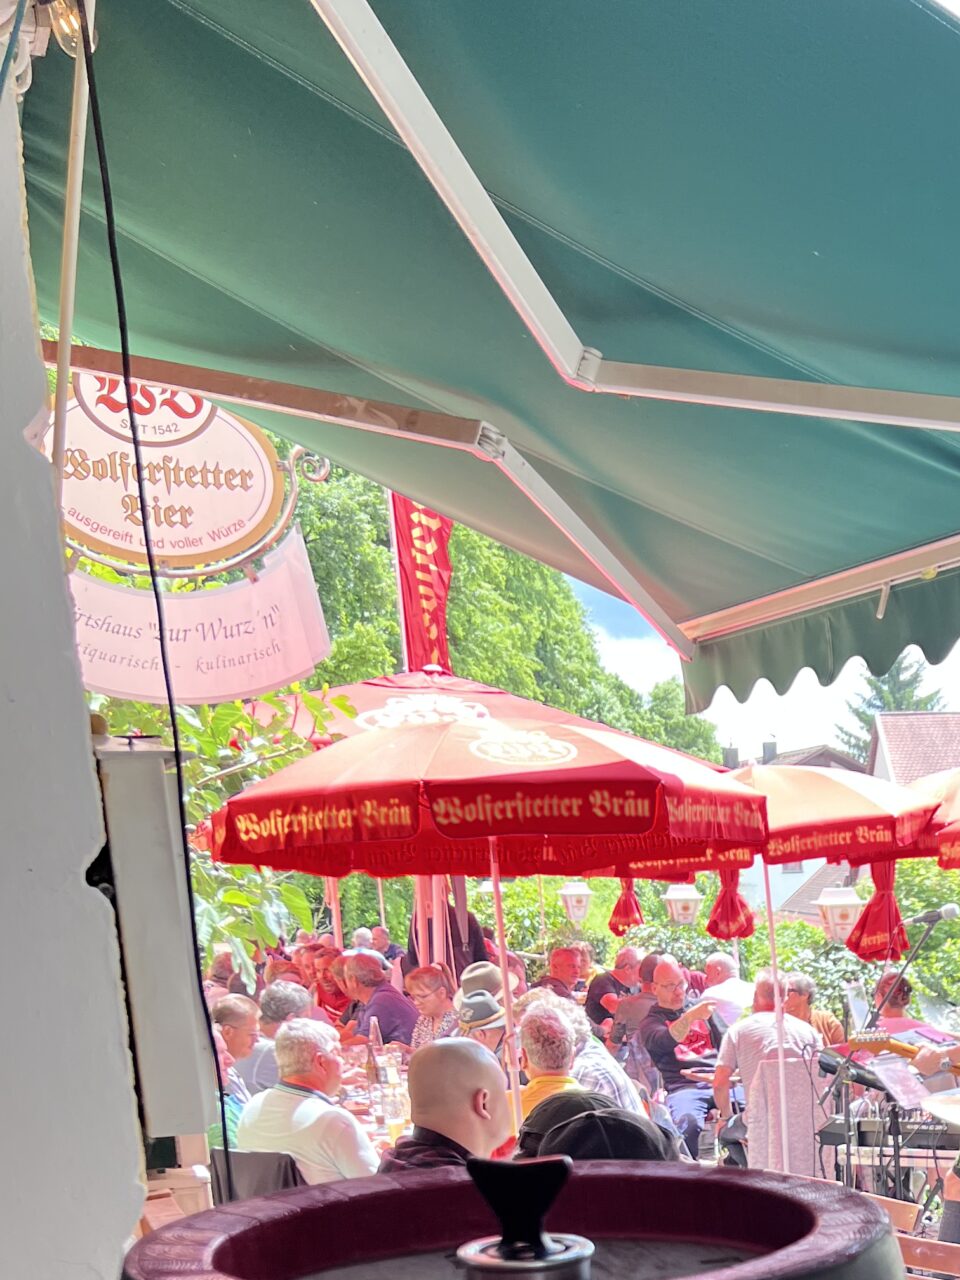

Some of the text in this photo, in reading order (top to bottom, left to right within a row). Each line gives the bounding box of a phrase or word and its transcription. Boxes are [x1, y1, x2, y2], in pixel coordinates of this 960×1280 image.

[151, 422, 180, 435] 1542
[67, 506, 134, 544] ausgereift
[170, 535, 204, 550] voller
[196, 638, 281, 675] kulinarisch
[235, 798, 412, 845] Wolferstetter Bräu
[432, 789, 650, 827] Wolferstetter Bräu
